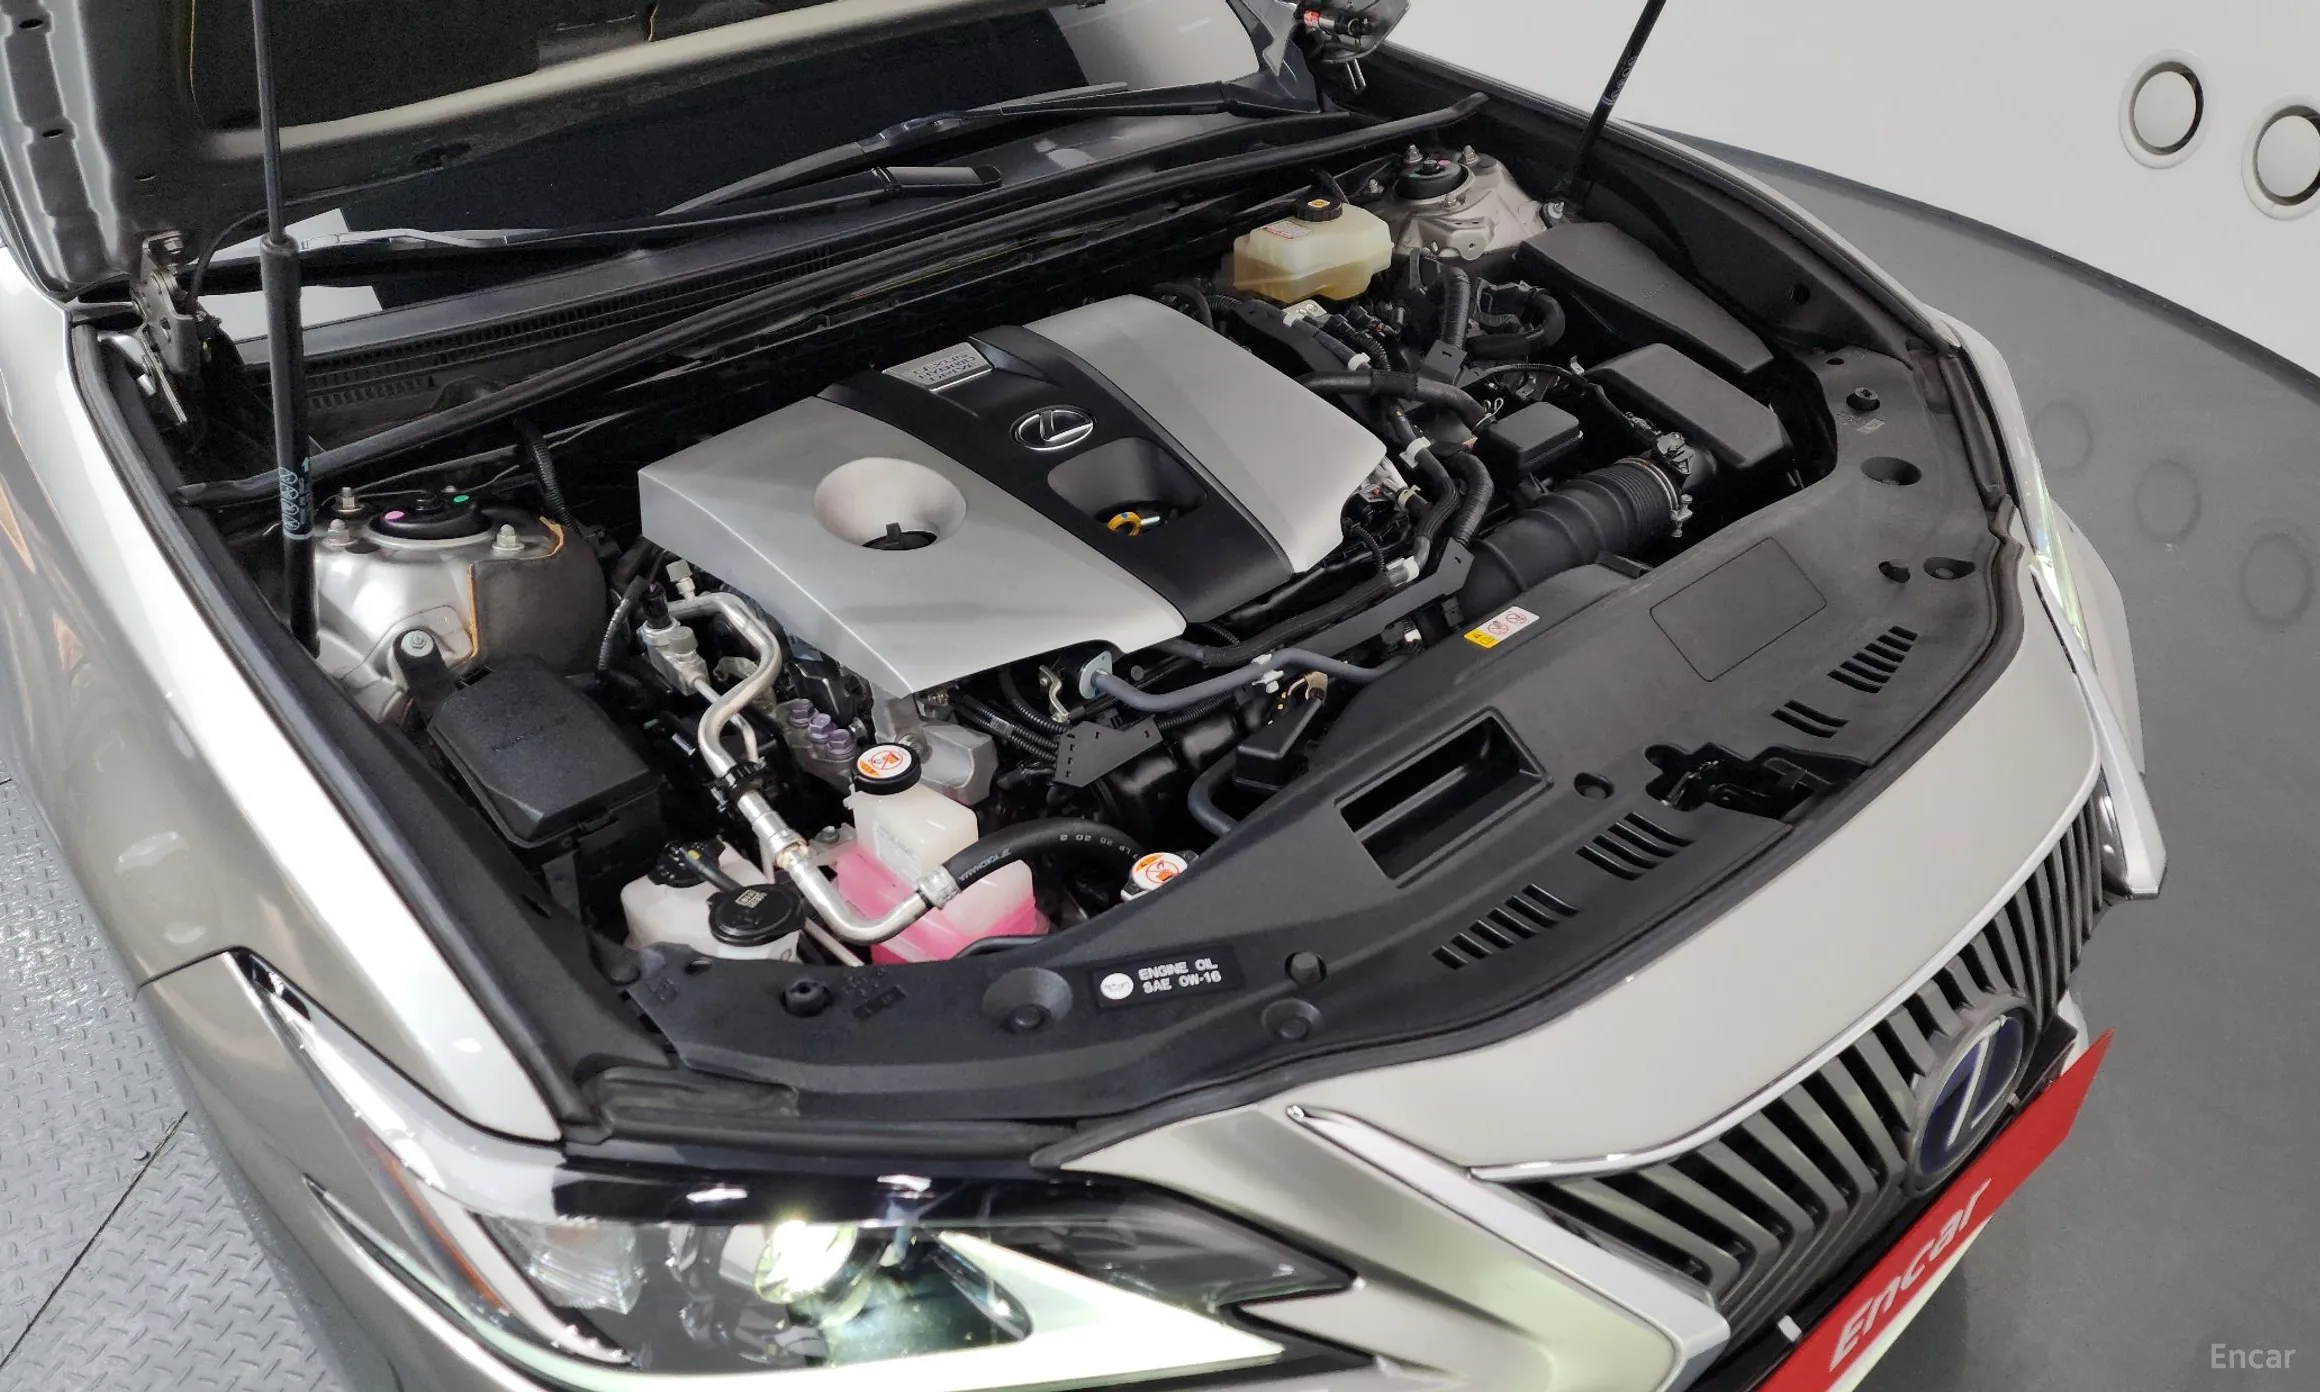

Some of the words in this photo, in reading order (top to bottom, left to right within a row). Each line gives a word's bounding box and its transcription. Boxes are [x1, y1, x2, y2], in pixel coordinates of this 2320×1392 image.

[1138, 961, 1189, 981] ENGINE
[1194, 957, 1218, 972] OIL
[1142, 978, 1172, 994] SAE
[1178, 970, 1222, 988] 0W-16
[1828, 1177, 1992, 1373] Encar
